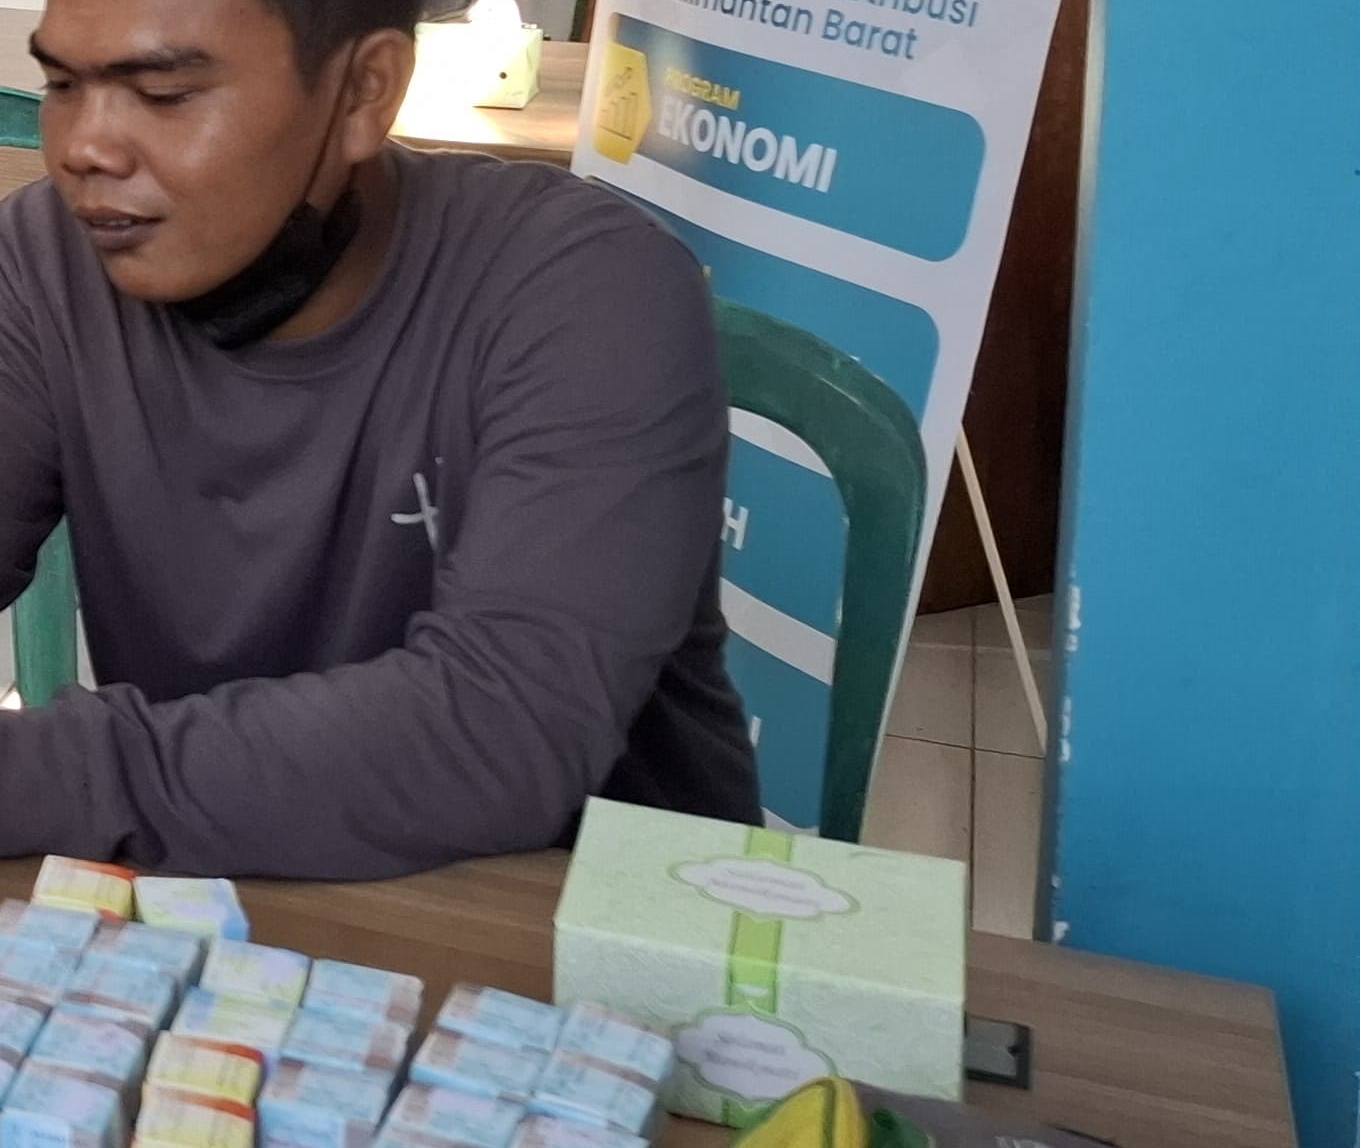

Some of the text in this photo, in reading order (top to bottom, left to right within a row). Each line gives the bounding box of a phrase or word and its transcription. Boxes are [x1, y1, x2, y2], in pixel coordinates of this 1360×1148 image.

[821, 11, 917, 60] Barat
[664, 68, 740, 109] PROGRAM
[657, 96, 838, 194] EKONOMI
